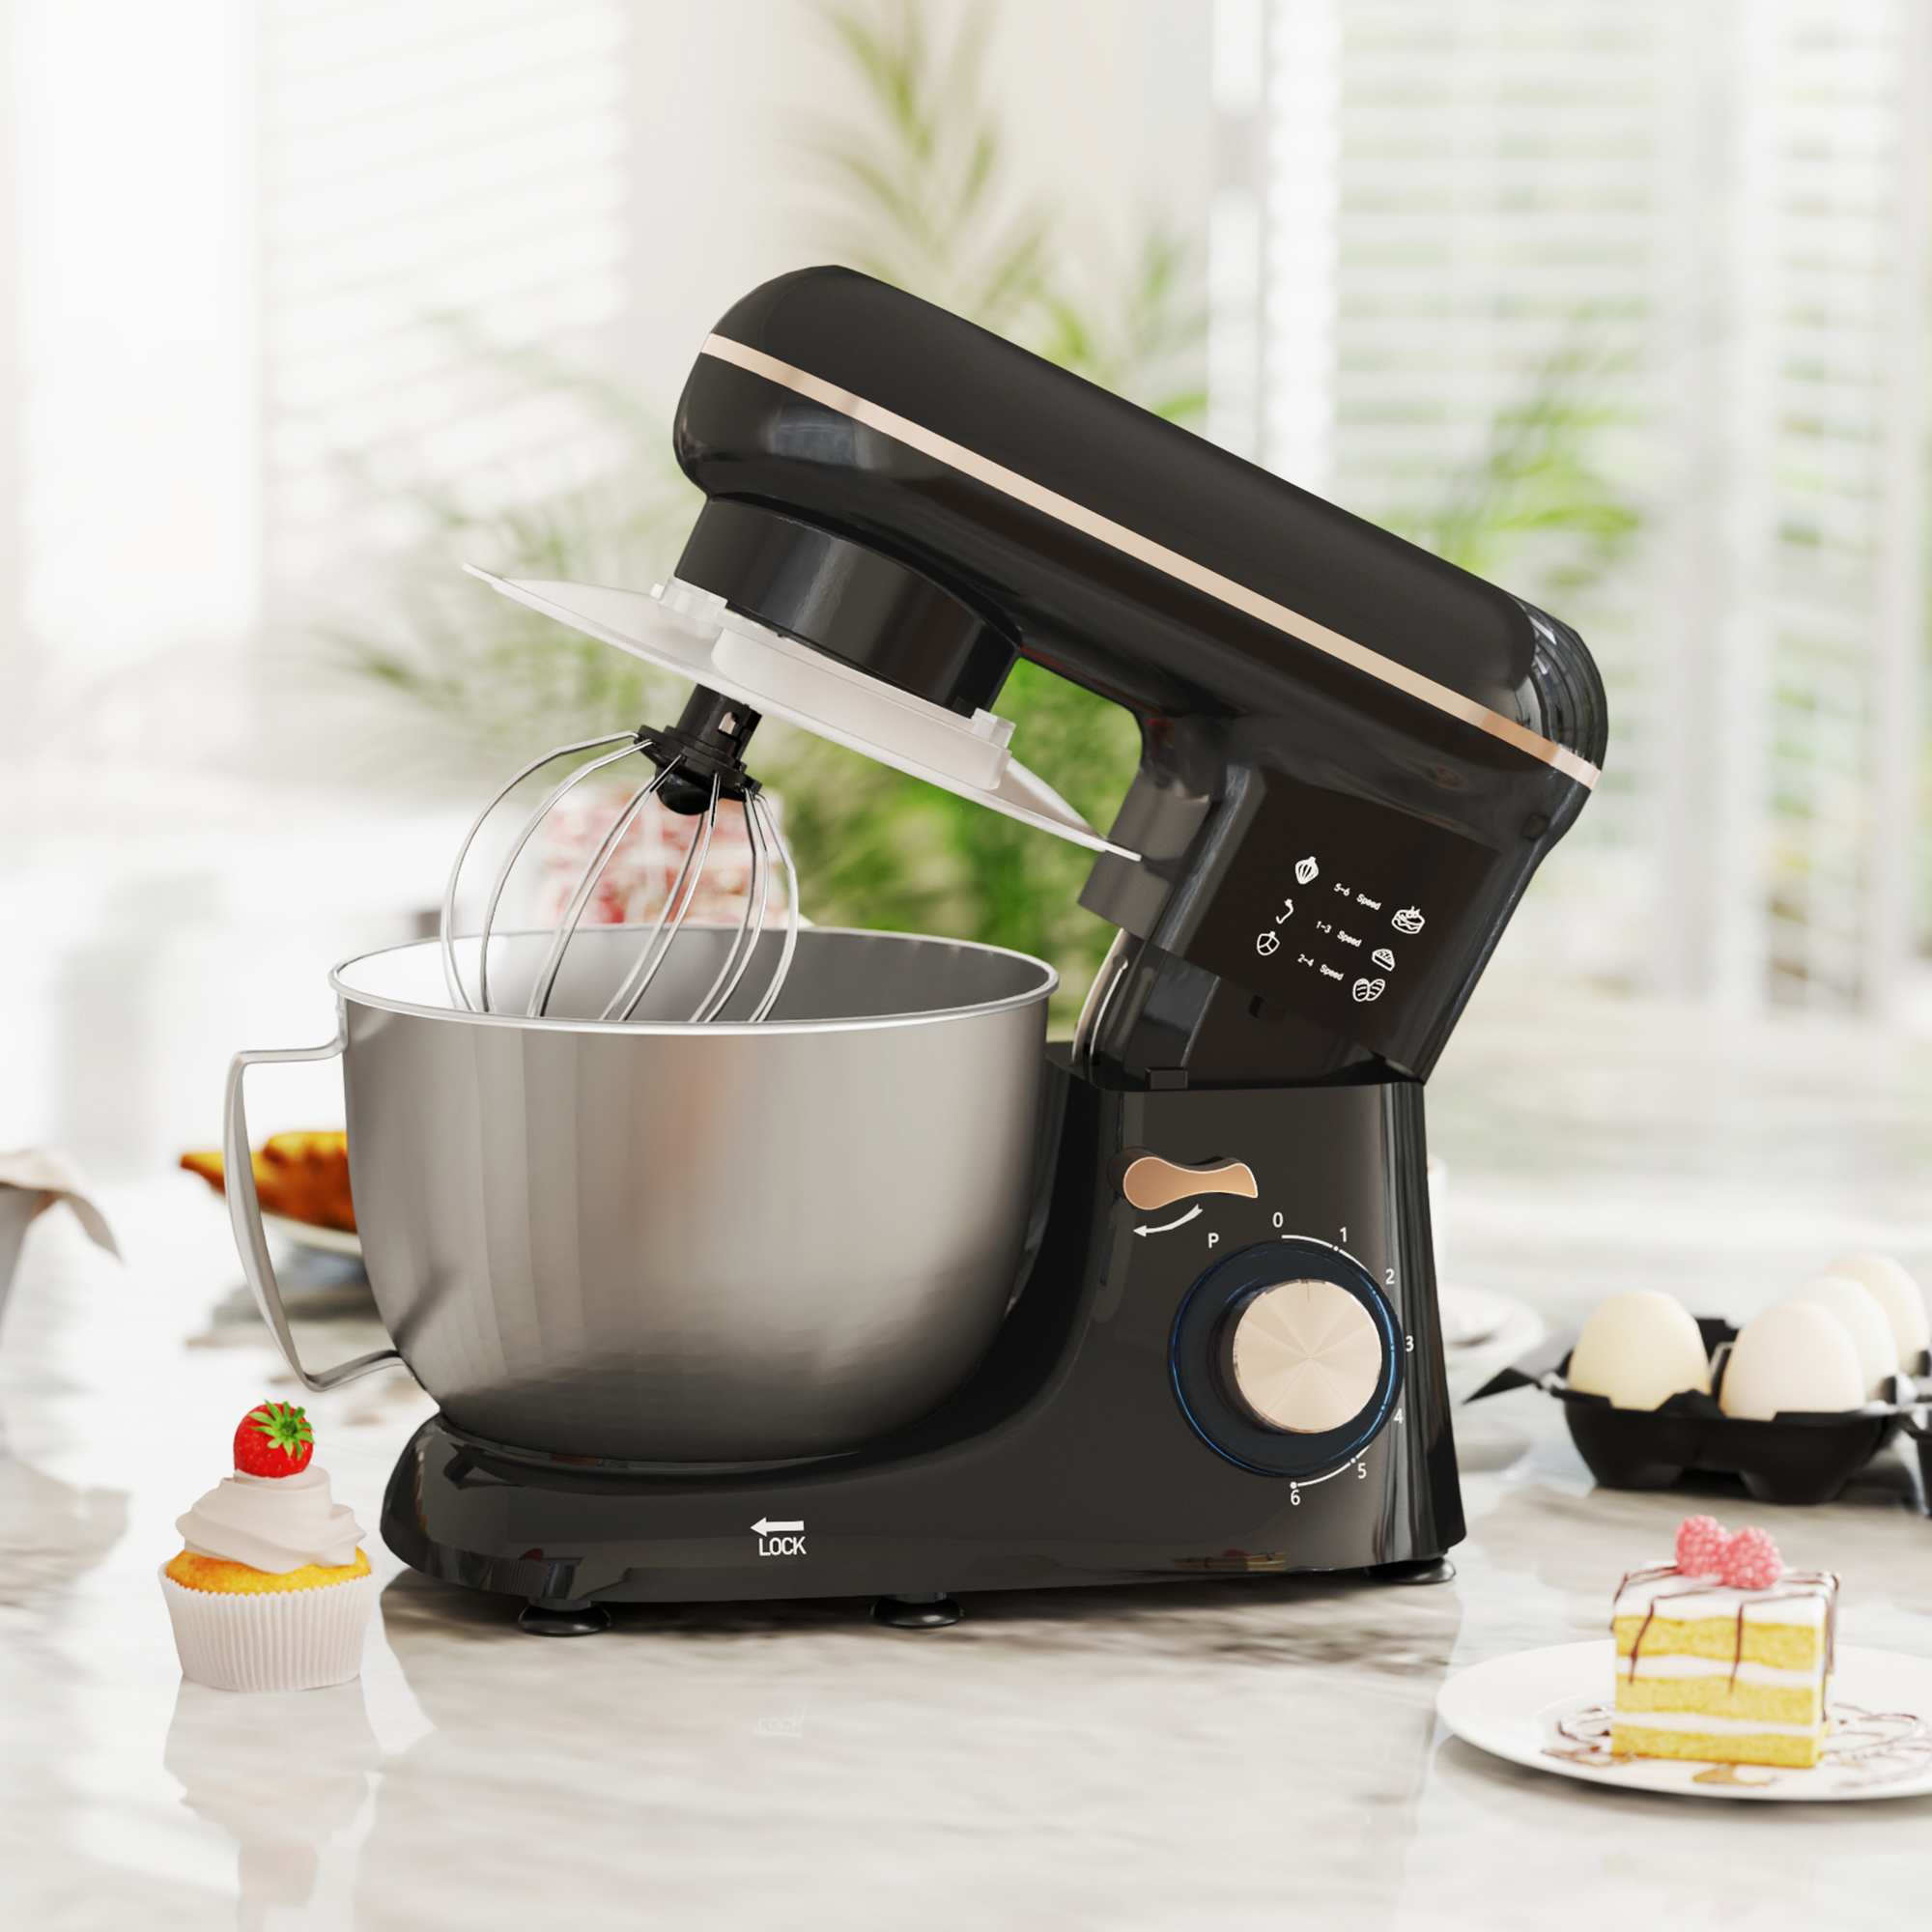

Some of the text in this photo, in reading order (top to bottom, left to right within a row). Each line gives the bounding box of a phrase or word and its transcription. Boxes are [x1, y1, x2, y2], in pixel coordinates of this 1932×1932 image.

[1333, 883, 1382, 911] 5-6 Speed
[1316, 921, 1362, 948] 1-3 Speed
[1297, 953, 1345, 981] 2-4 Speed
[1272, 1211, 1284, 1229] 0
[1208, 1232, 1220, 1249] P
[1339, 1226, 1348, 1243] 1
[1385, 1267, 1396, 1286] 2
[1405, 1335, 1414, 1352] 3
[1393, 1407, 1404, 1424] 4
[1357, 1462, 1368, 1480] 5
[1290, 1489, 1301, 1506] 6
[758, 1536, 807, 1557] LOCK
